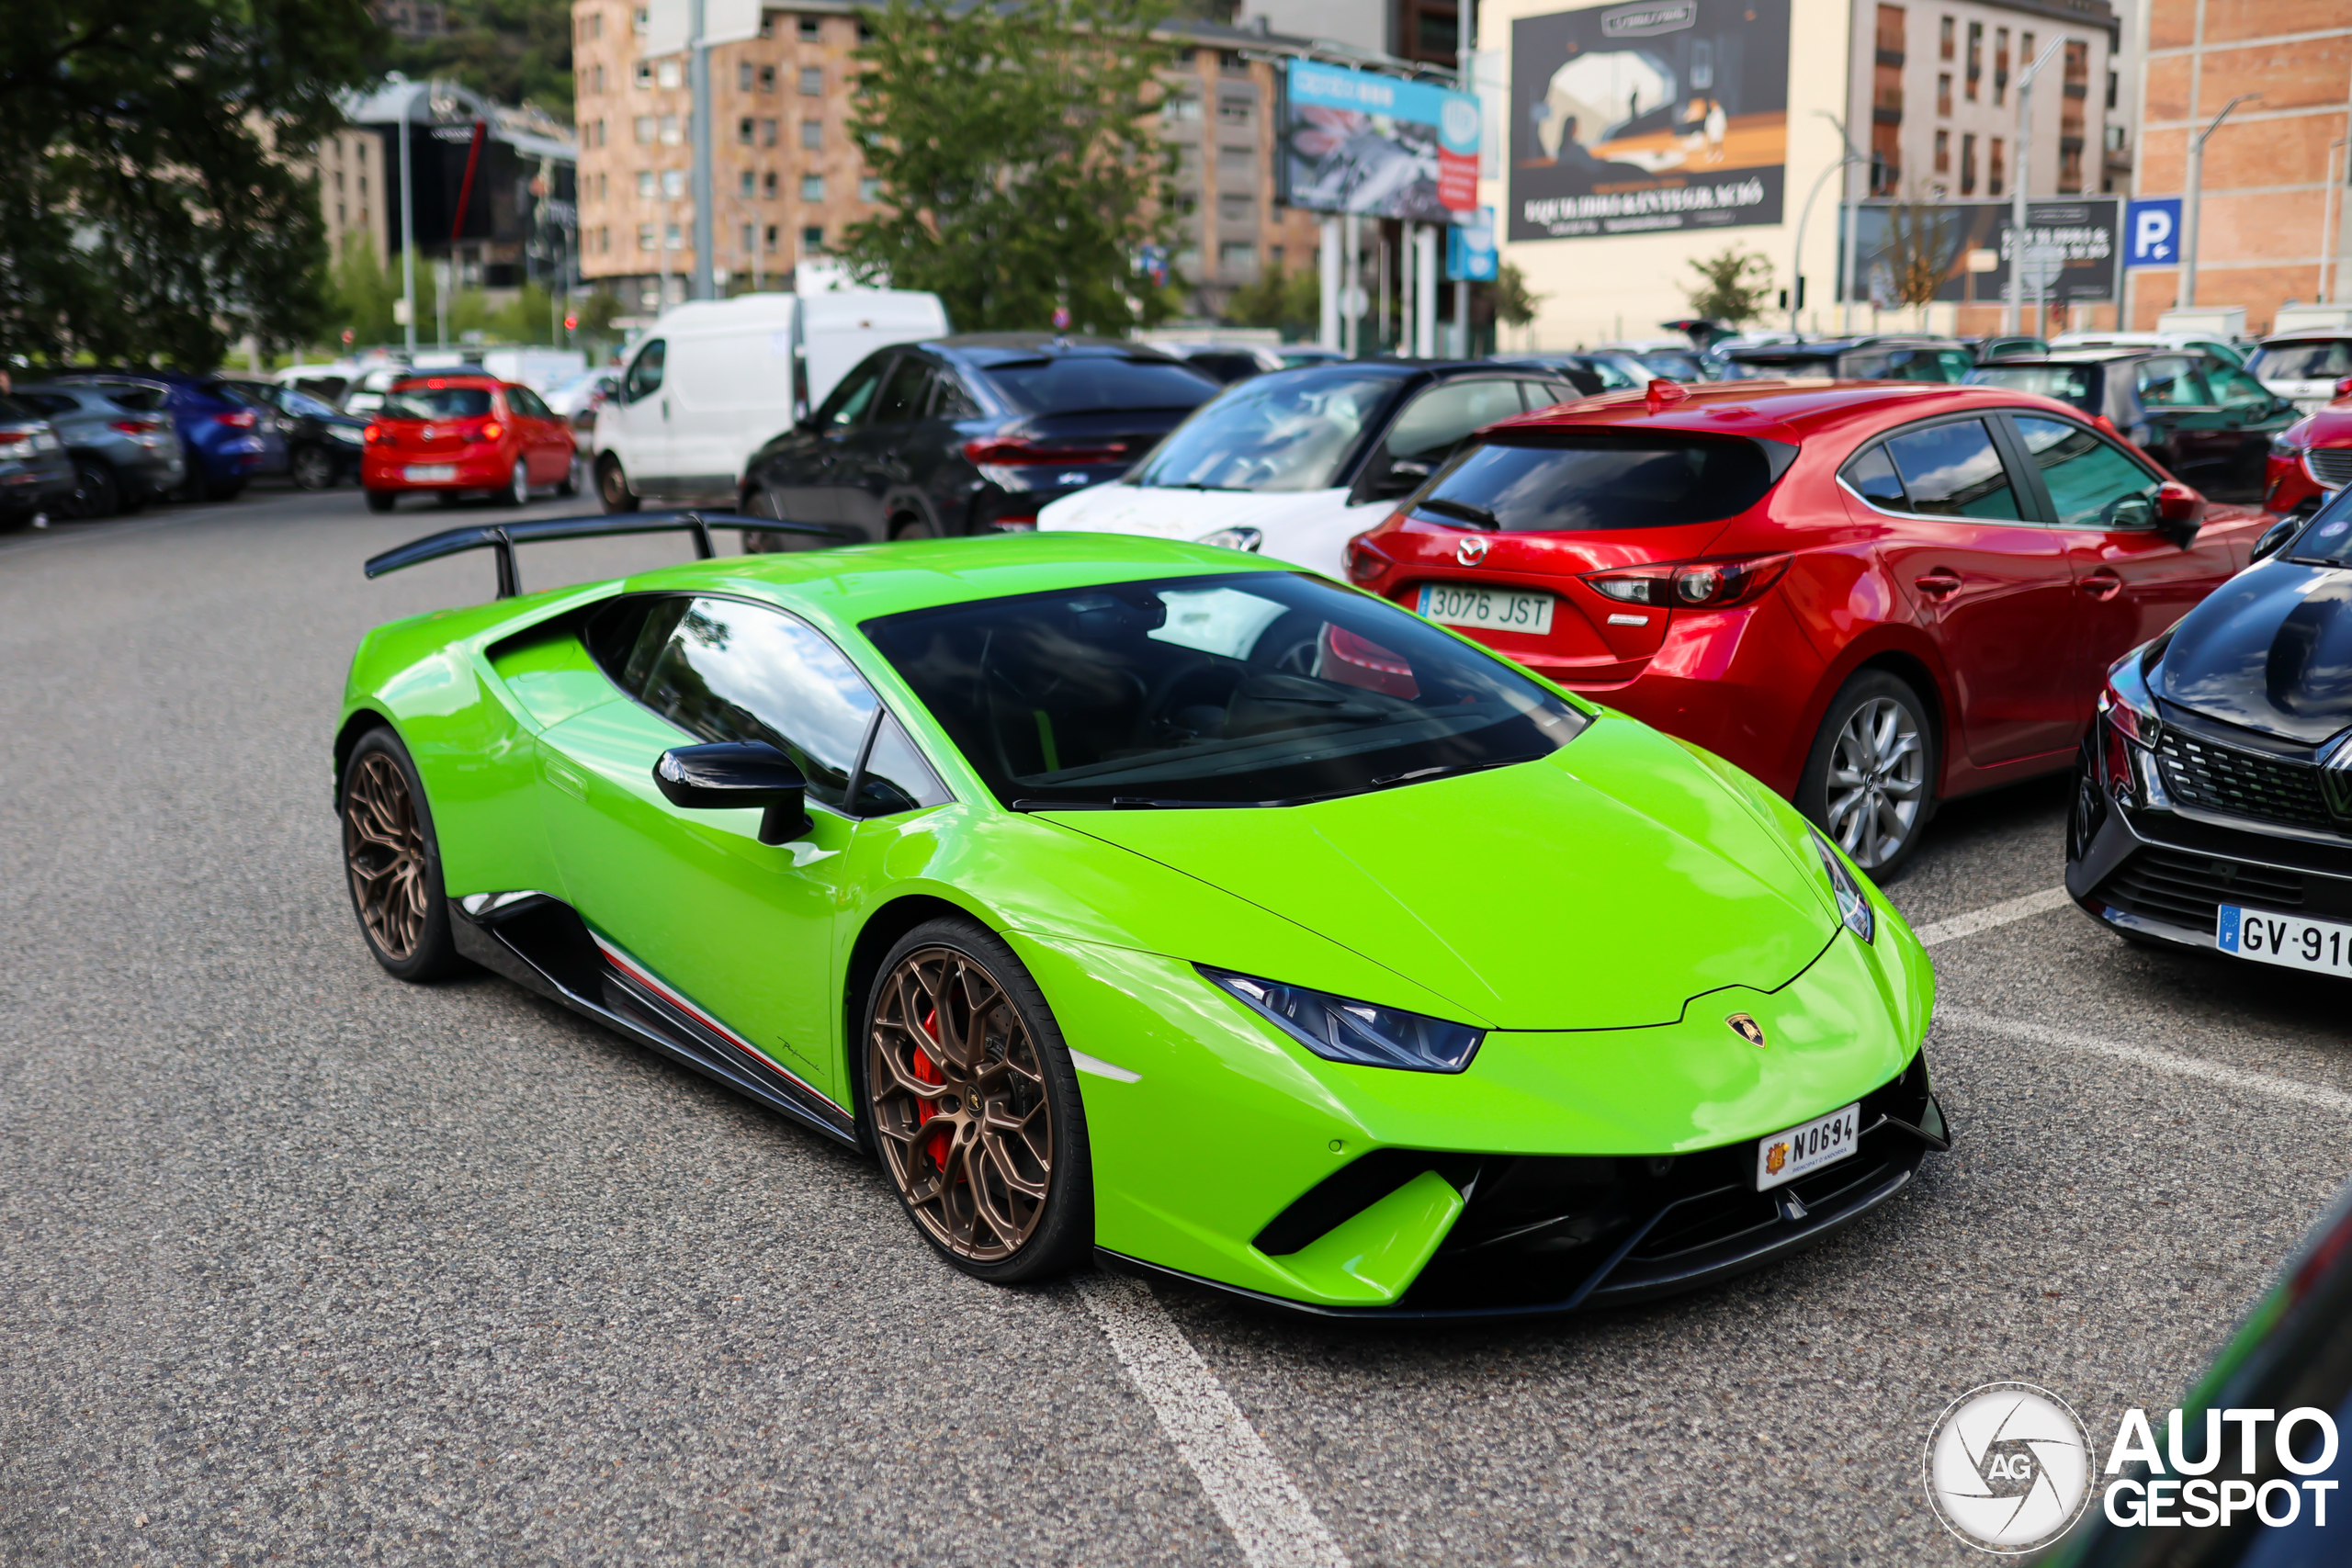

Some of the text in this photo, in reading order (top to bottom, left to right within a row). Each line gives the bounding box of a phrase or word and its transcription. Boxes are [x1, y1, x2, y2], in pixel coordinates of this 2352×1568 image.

[2134, 209, 2173, 258] P
[1432, 591, 1491, 620] 3076
[1498, 596, 1548, 626] JST
[2225, 932, 2233, 942] F
[2245, 918, 2352, 967] GV-91
[1792, 1114, 1852, 1162] N0694
[1792, 1147, 1848, 1174] PRINCIPAT D'ANDORRA
